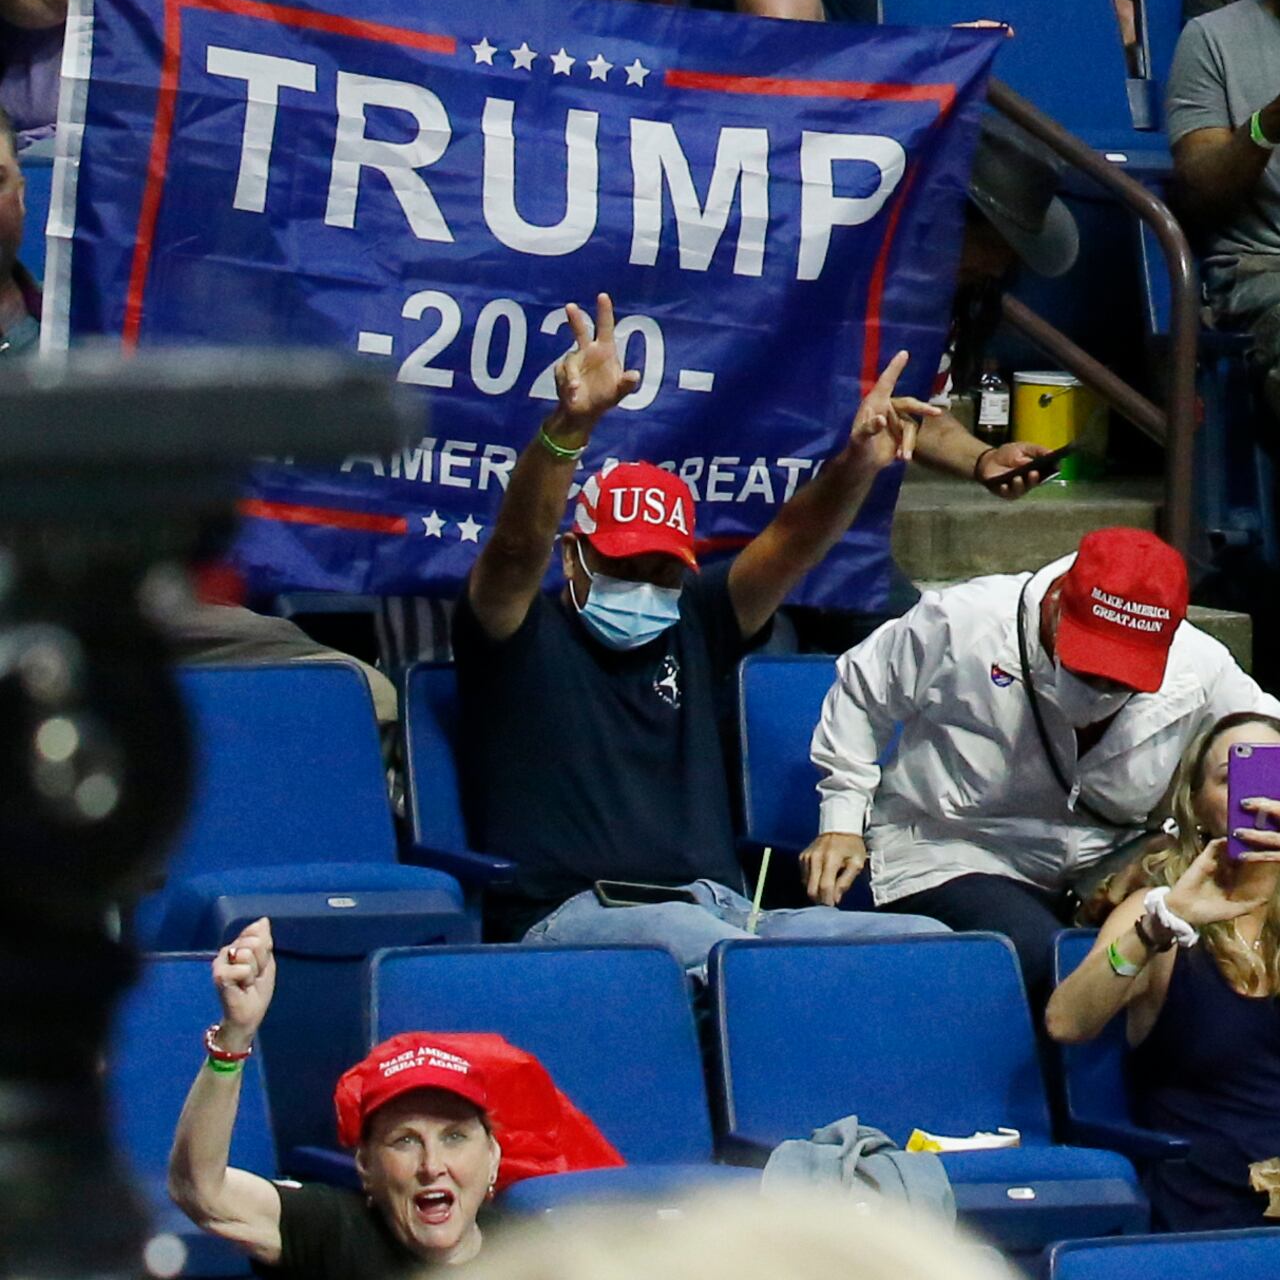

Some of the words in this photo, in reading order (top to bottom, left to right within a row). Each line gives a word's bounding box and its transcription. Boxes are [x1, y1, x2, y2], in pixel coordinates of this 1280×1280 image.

[206, 45, 908, 283] TRUMP
[609, 487, 690, 536] USA
[1092, 586, 1121, 607] MAKE
[1121, 594, 1171, 620] AMERICA
[1092, 604, 1130, 628] GREAT
[1129, 609, 1164, 632] AGAIN
[384, 1060, 424, 1077] GREAT
[417, 1046, 471, 1067] AMERICA
